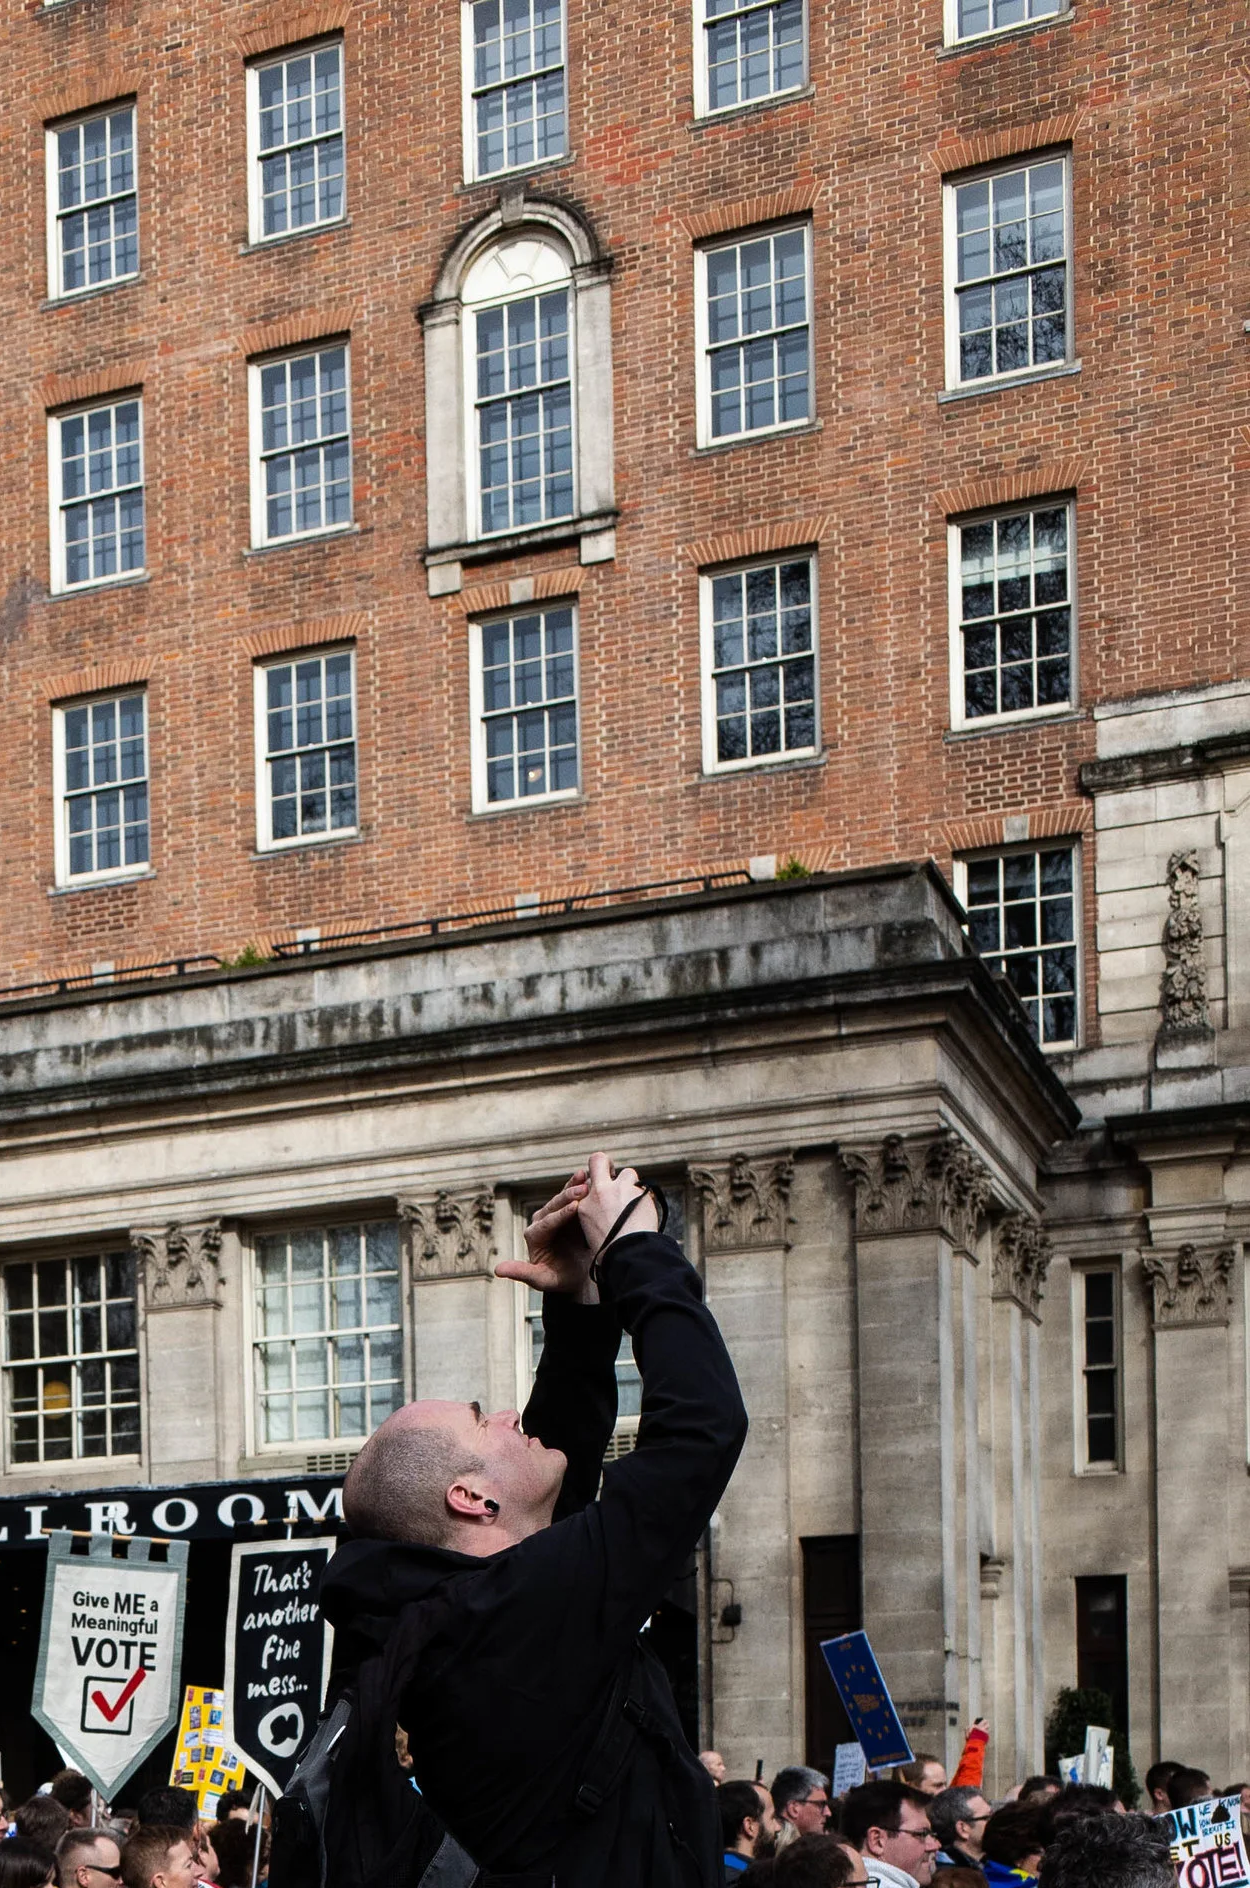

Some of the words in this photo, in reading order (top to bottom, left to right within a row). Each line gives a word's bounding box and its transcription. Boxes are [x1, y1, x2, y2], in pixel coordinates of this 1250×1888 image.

[254, 1561, 312, 1596] That's
[73, 1591, 109, 1608] Give
[114, 1592, 146, 1615] ME
[150, 1600, 158, 1612] a
[243, 1596, 319, 1631] another
[71, 1612, 158, 1636] Meaningful
[71, 1636, 157, 1671] VOTE
[247, 1675, 308, 1700] mess...
[1165, 1807, 1198, 1842] OW
[1170, 1838, 1200, 1860] ET
[1214, 1833, 1232, 1849] US
